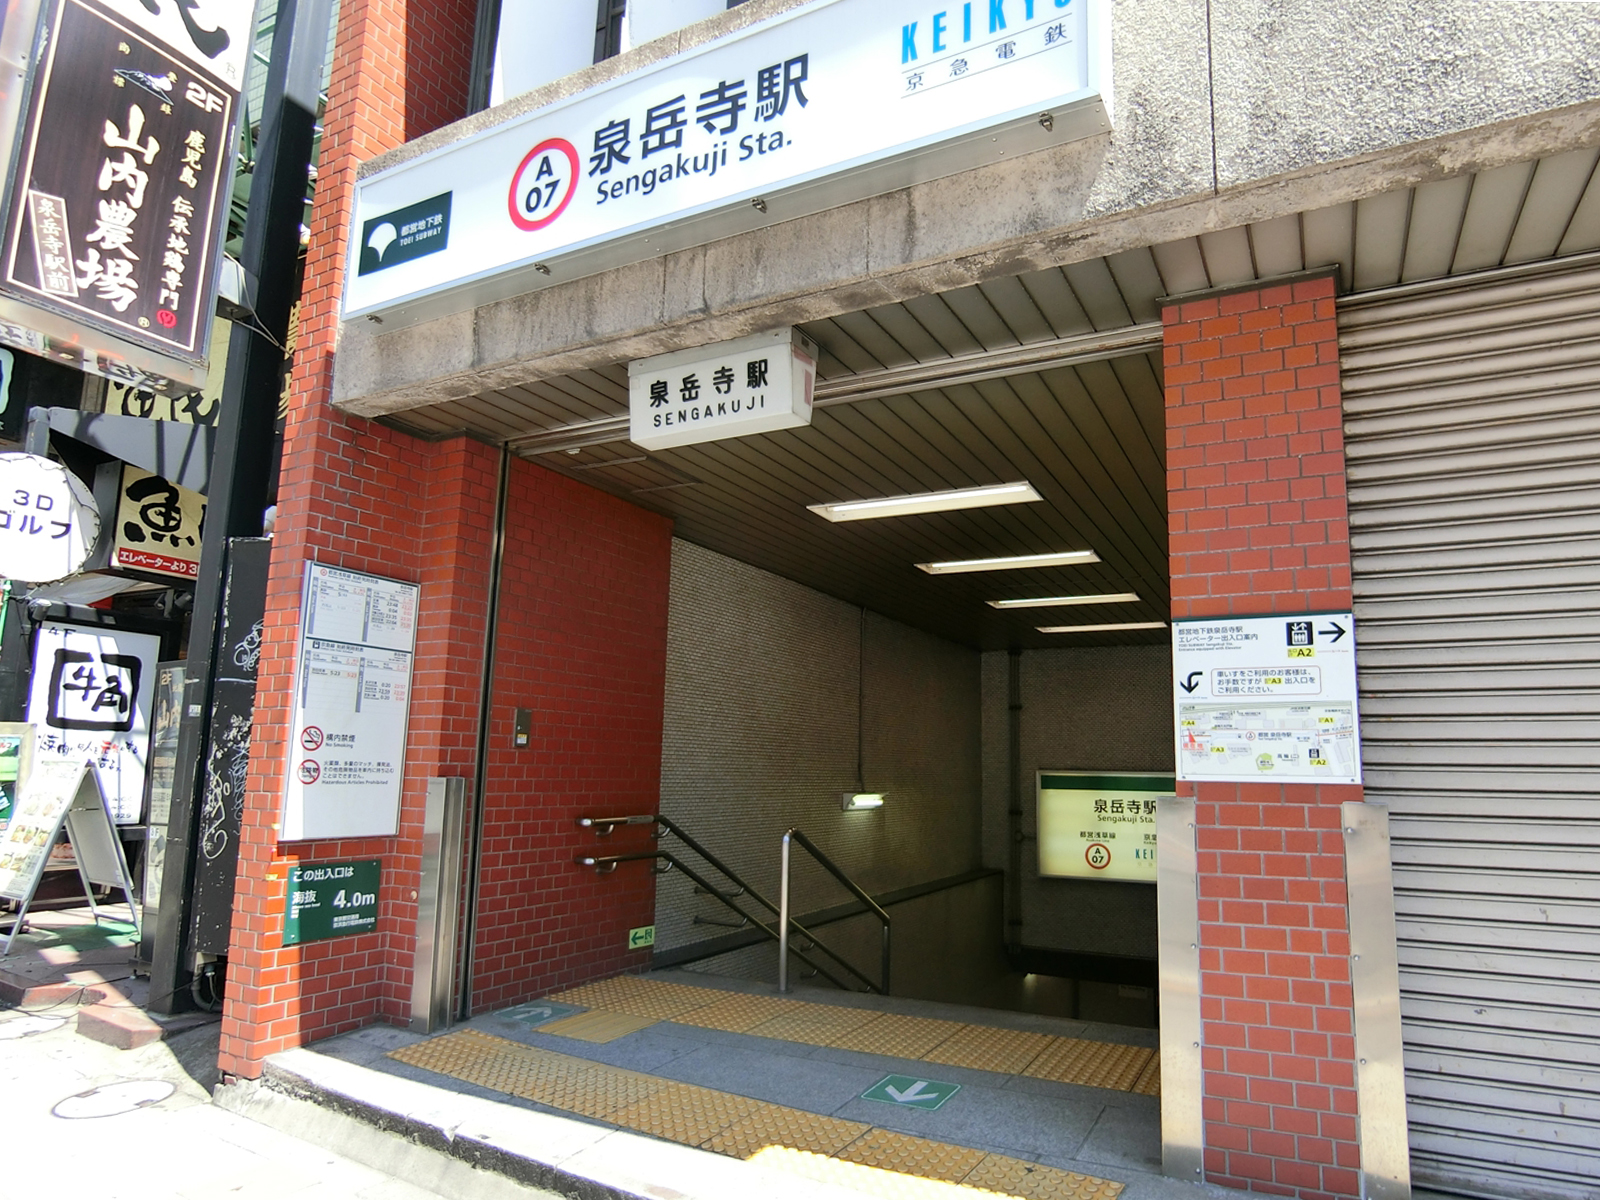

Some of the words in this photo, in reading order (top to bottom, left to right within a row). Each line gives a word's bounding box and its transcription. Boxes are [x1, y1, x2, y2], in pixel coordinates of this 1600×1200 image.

[902, 0, 1072, 63] KEIKY
[906, 22, 1068, 91] 京急電鉄
[186, 81, 224, 113] 2F
[588, 53, 810, 177] 泉岳寺駅
[179, 129, 206, 189] 鹿児島
[536, 156, 553, 181] A
[596, 139, 728, 205] Sengakuji
[739, 129, 793, 163] Sta.
[525, 179, 562, 213] 07
[76, 104, 161, 312] 山内農場
[401, 213, 443, 236] 都営地下鉄
[36, 197, 70, 293] 泉岳寺駅前
[400, 234, 414, 247] TOEI
[415, 226, 442, 244] SUBWAY
[650, 359, 768, 408] 泉岳寺駅
[653, 395, 764, 428] SENGAKUJI
[13, 490, 54, 512] 3D
[119, 550, 187, 573] エレベーターより
[1178, 626, 1243, 636] 都営地下鉄泉岳寺駅
[1178, 633, 1259, 642] エレベーター出入口案内
[1297, 648, 1312, 657] A2
[63, 666, 128, 713] 牛角
[1284, 677, 1316, 685] 出入口を
[326, 733, 356, 743] 構内禁煙
[1094, 799, 1156, 814] 泉岳寺駅
[1097, 815, 1138, 824] Sengakuji
[1091, 856, 1104, 864] 07
[292, 866, 354, 882] この出入口は
[291, 890, 317, 903] 海抜
[333, 890, 376, 909] 4.0m
